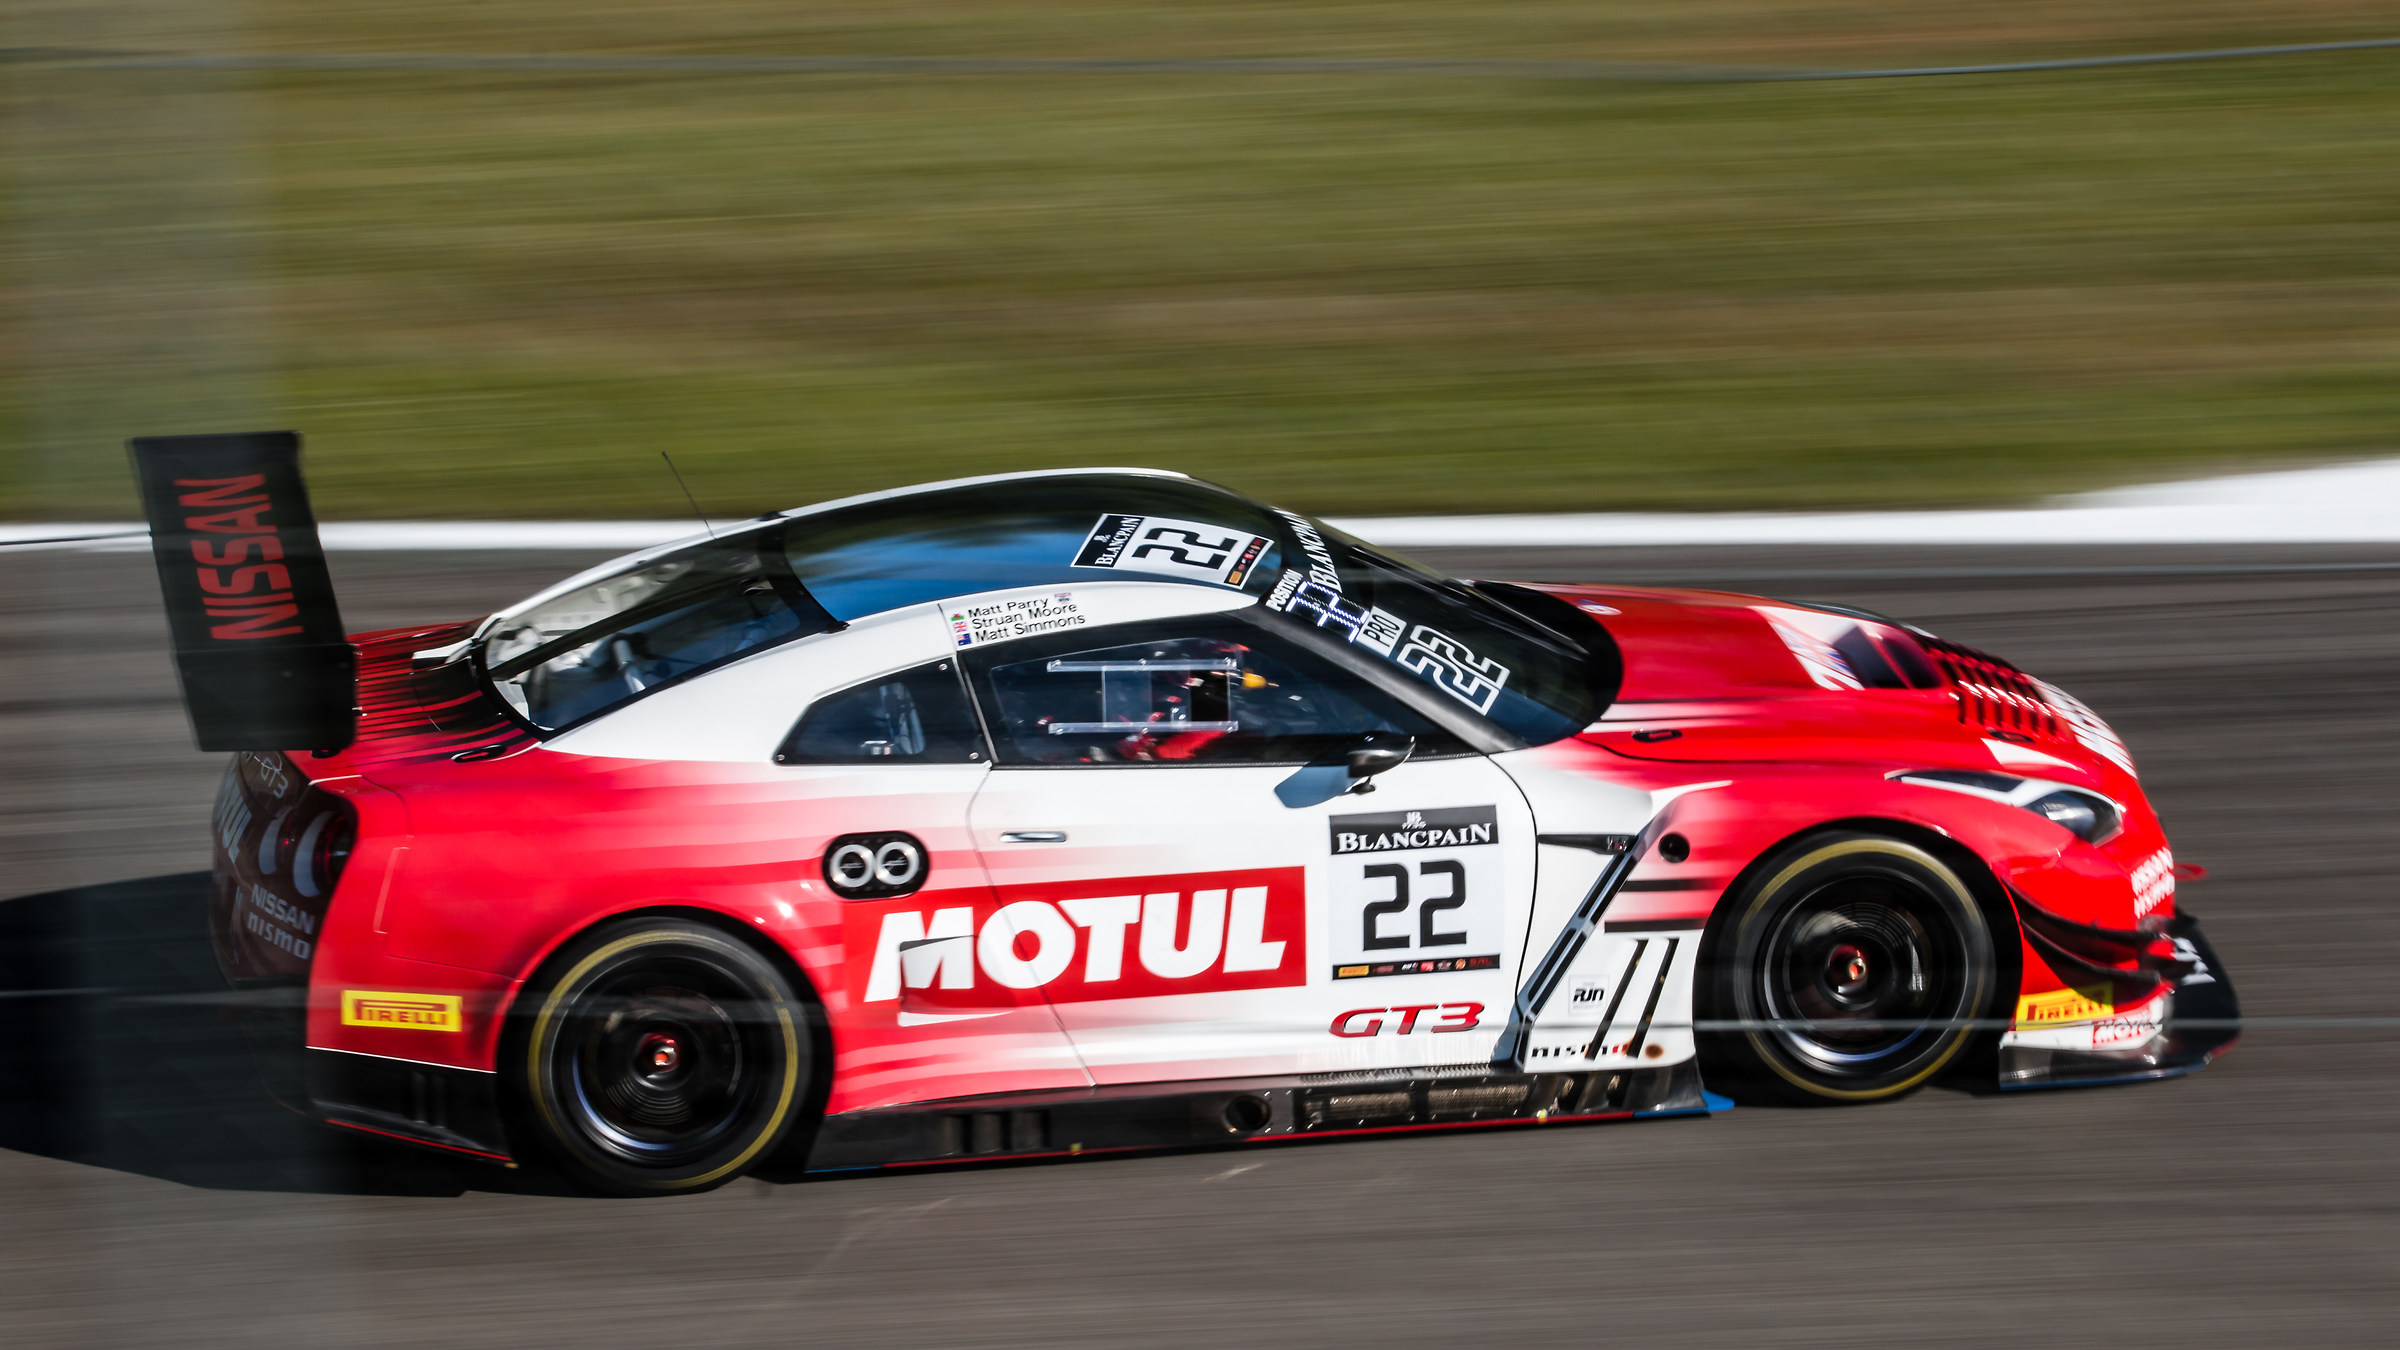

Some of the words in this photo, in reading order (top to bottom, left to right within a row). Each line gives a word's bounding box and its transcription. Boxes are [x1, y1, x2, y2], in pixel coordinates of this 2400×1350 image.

[173, 474, 304, 640] NISSAN
[1095, 517, 1141, 565] BLANCPAIN
[1132, 527, 1238, 570] 22
[968, 604, 1002, 618] Matt
[1007, 598, 1048, 611] Parry
[1265, 568, 1303, 612] POSITION
[972, 613, 1022, 629] Struan
[1029, 604, 1077, 618] Moore
[975, 627, 1009, 643] Matt
[1014, 614, 1086, 635] Simmons
[1363, 614, 1401, 648] PRO
[1397, 625, 1511, 716] 22
[1336, 823, 1492, 853] BLANCPAIN
[250, 883, 316, 934] NISSAN
[1363, 860, 1468, 951] 22
[864, 886, 1287, 1002] MOTUL
[352, 999, 449, 1026] PIRELLI
[1328, 1001, 1485, 1038] GT3
